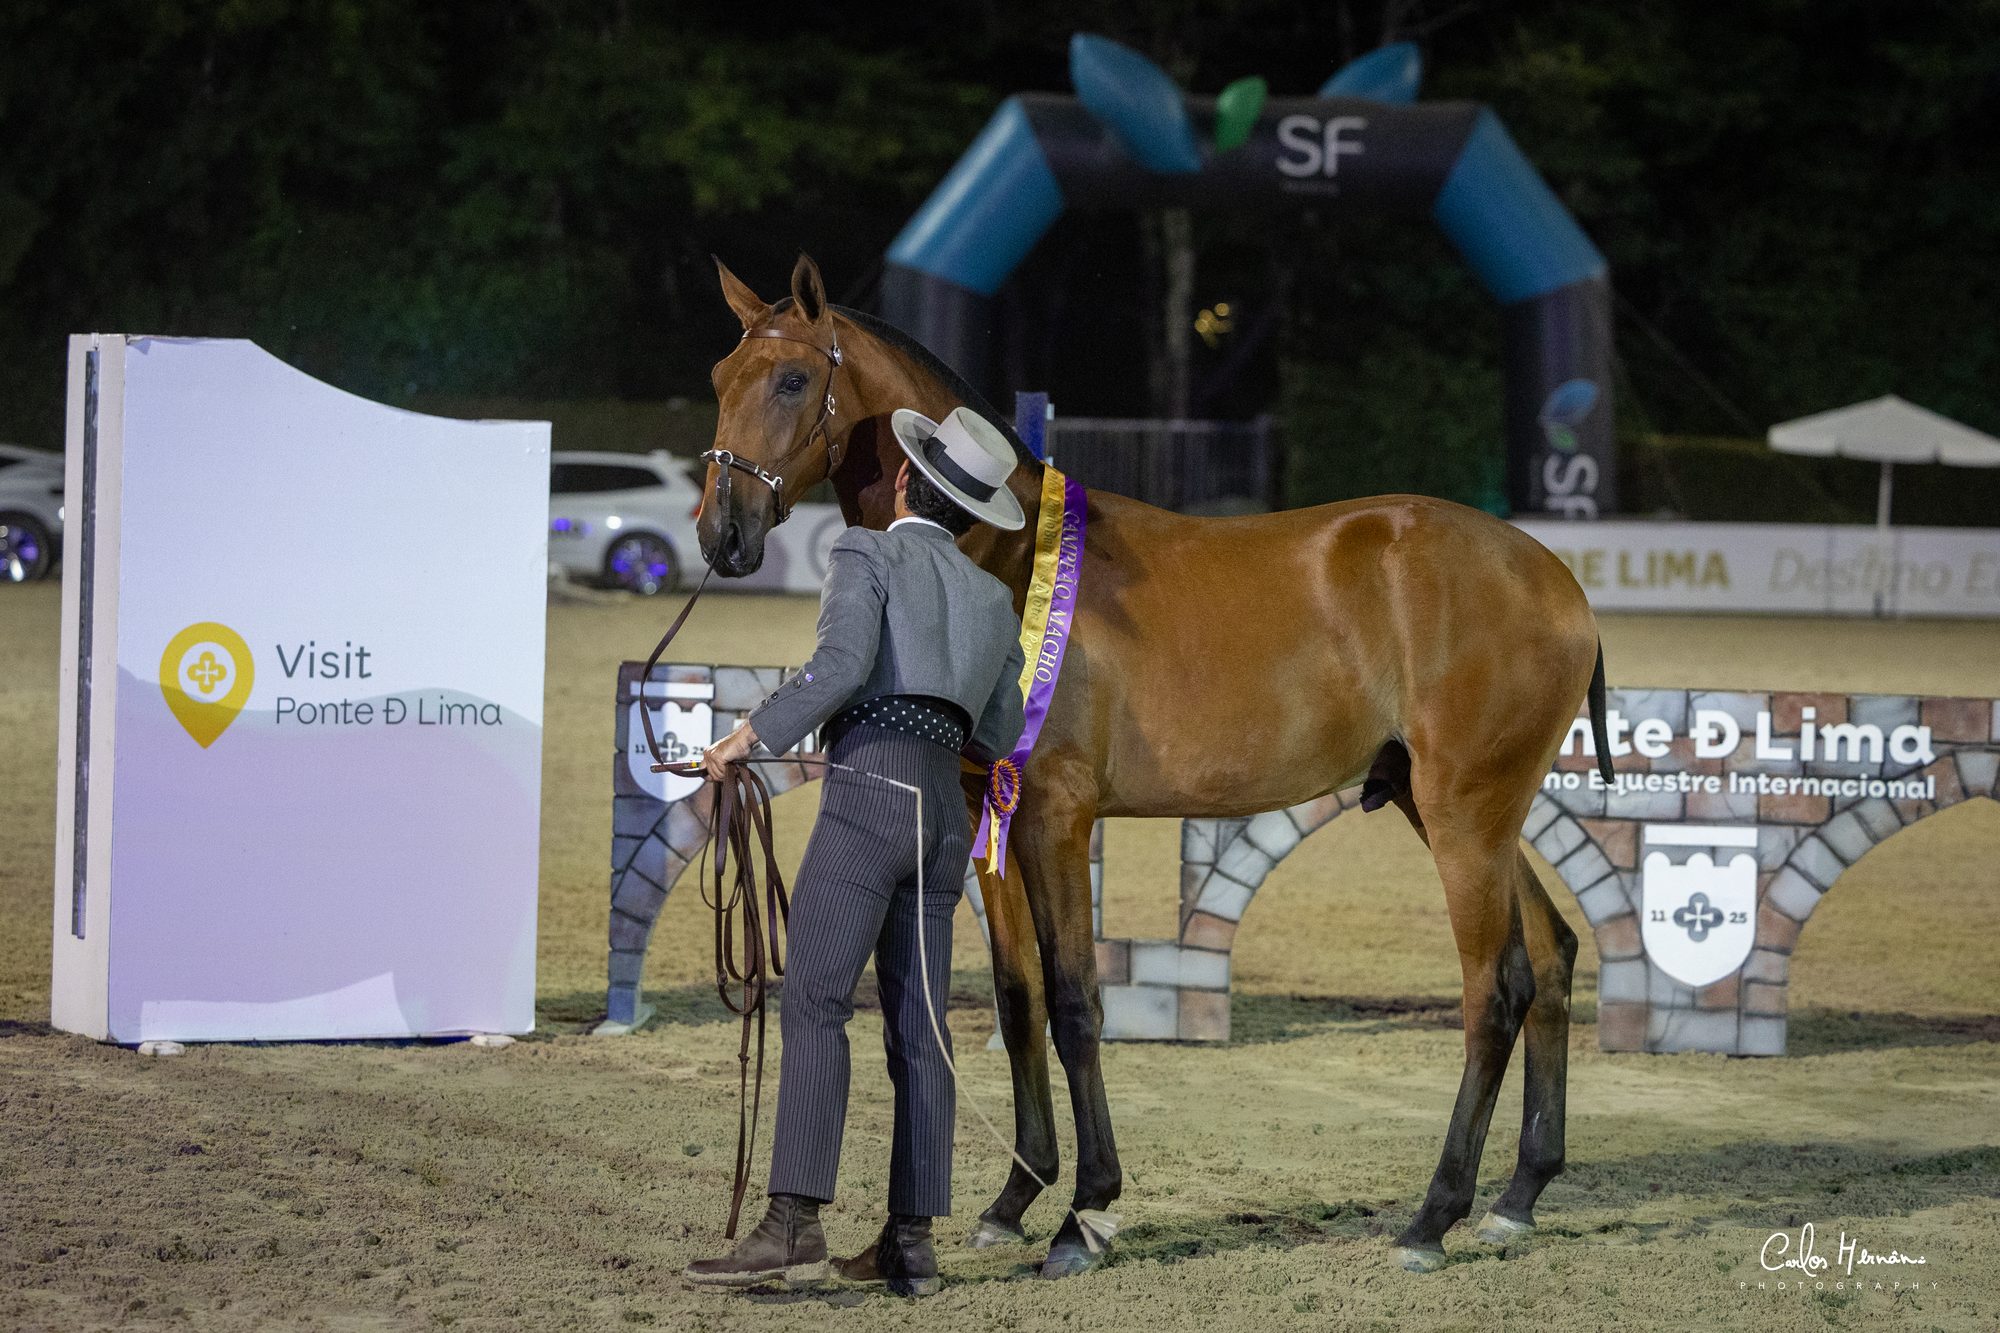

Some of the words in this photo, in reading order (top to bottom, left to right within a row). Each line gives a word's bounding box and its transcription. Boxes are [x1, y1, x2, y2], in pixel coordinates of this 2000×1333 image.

[1276, 114, 1369, 178] SF
[1055, 511, 1080, 600] CAMPEÃO
[1617, 548, 1732, 589] LIMA
[276, 641, 372, 679] Visit
[1036, 609, 1067, 682] MACHO
[276, 697, 373, 725] Ponte
[418, 695, 503, 726] Lima
[1559, 710, 1673, 758] nte
[1756, 706, 1936, 765] Lima
[1588, 768, 1721, 796] Equestre
[1729, 772, 1935, 799] Internacional
[1651, 910, 1665, 922] 11
[1729, 912, 1748, 923] 25
